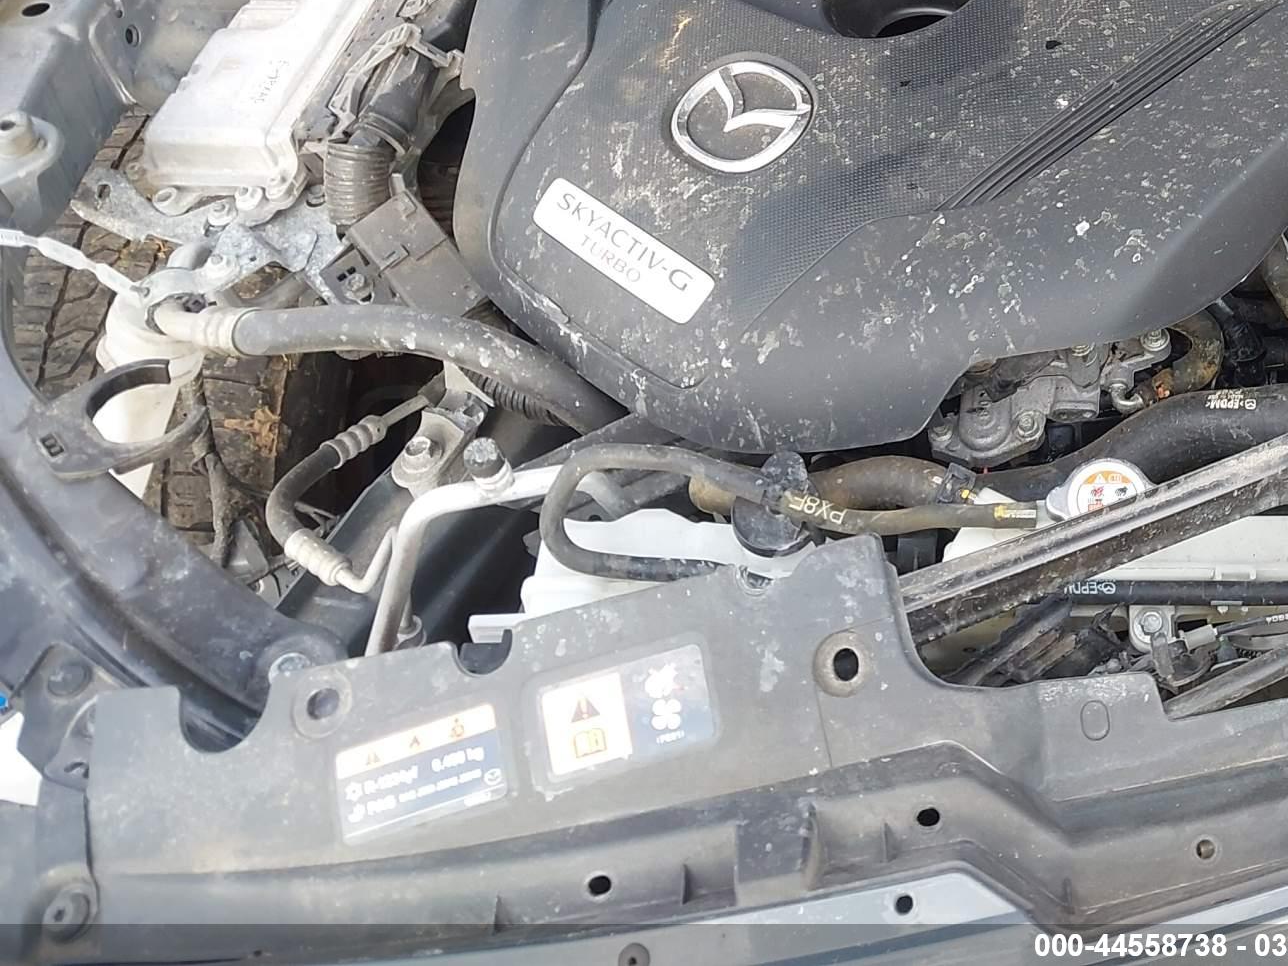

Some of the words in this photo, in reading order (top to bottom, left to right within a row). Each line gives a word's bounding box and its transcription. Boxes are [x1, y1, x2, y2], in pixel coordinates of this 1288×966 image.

[556, 192, 693, 292] SKYACTIV-G
[580, 234, 641, 284] TURBO
[787, 493, 847, 525] PX8F
